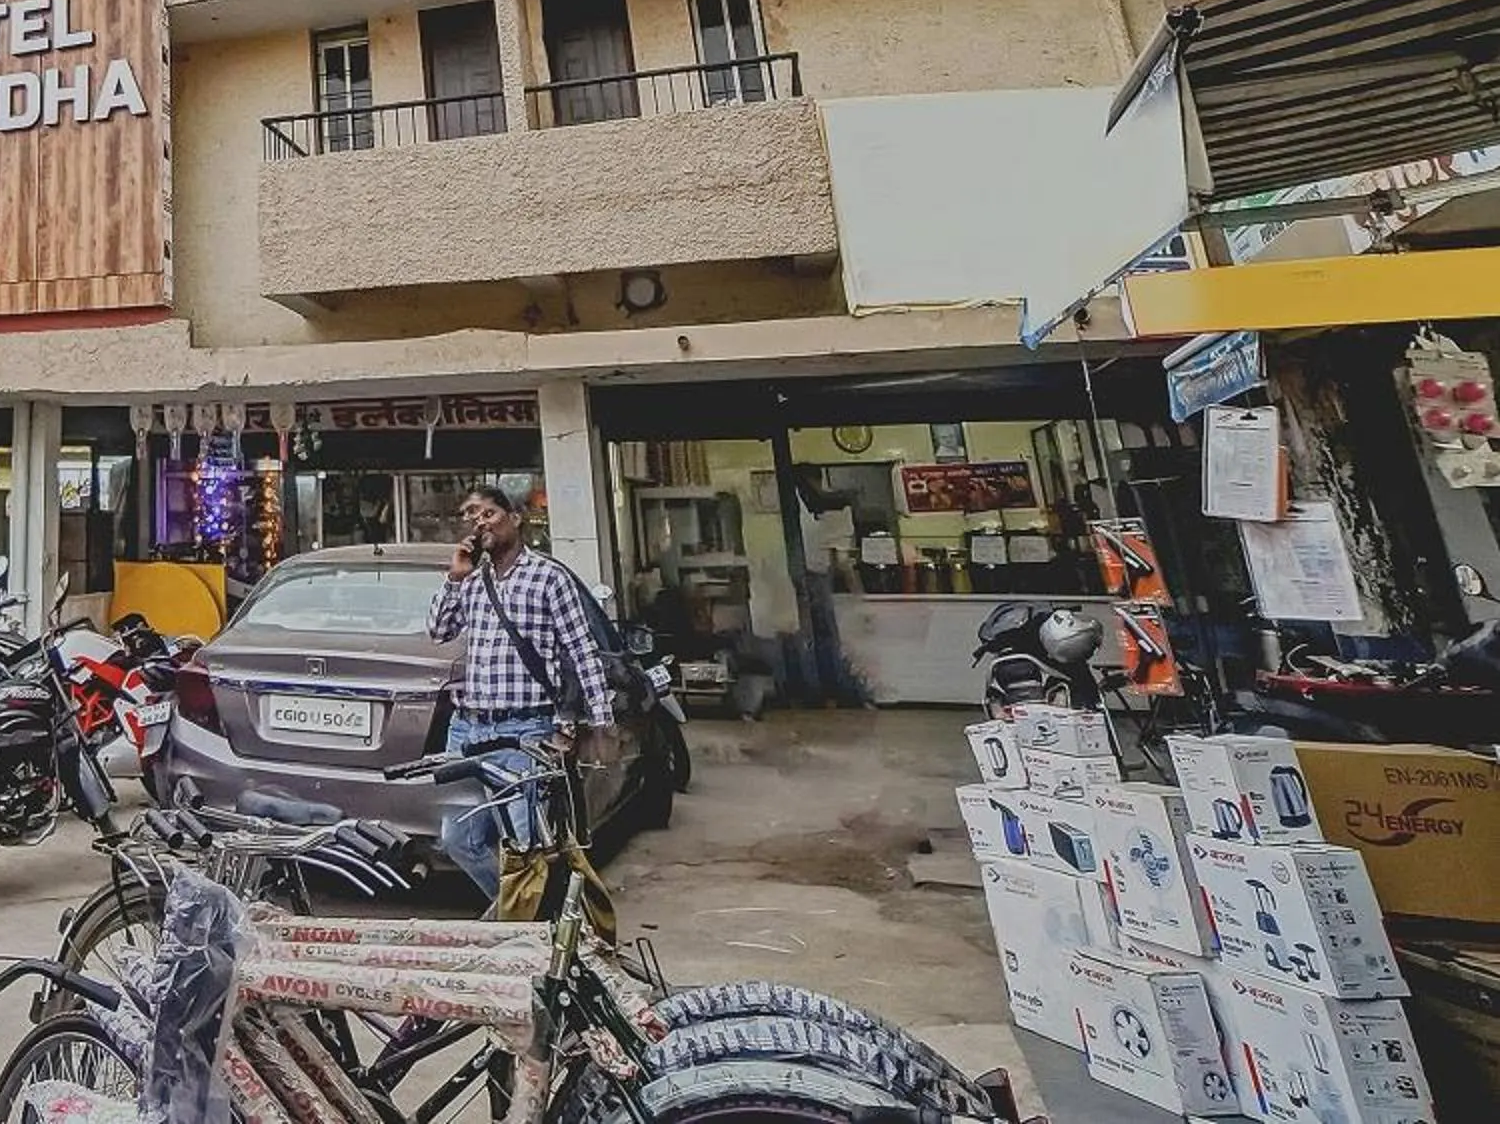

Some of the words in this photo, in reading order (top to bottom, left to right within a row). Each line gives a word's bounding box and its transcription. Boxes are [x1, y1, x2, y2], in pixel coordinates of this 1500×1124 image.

[1385, 815, 1464, 836] ENERGY
[262, 975, 330, 999] AVON
[336, 983, 393, 1003] CYCLES
[402, 995, 474, 1018] AVON
